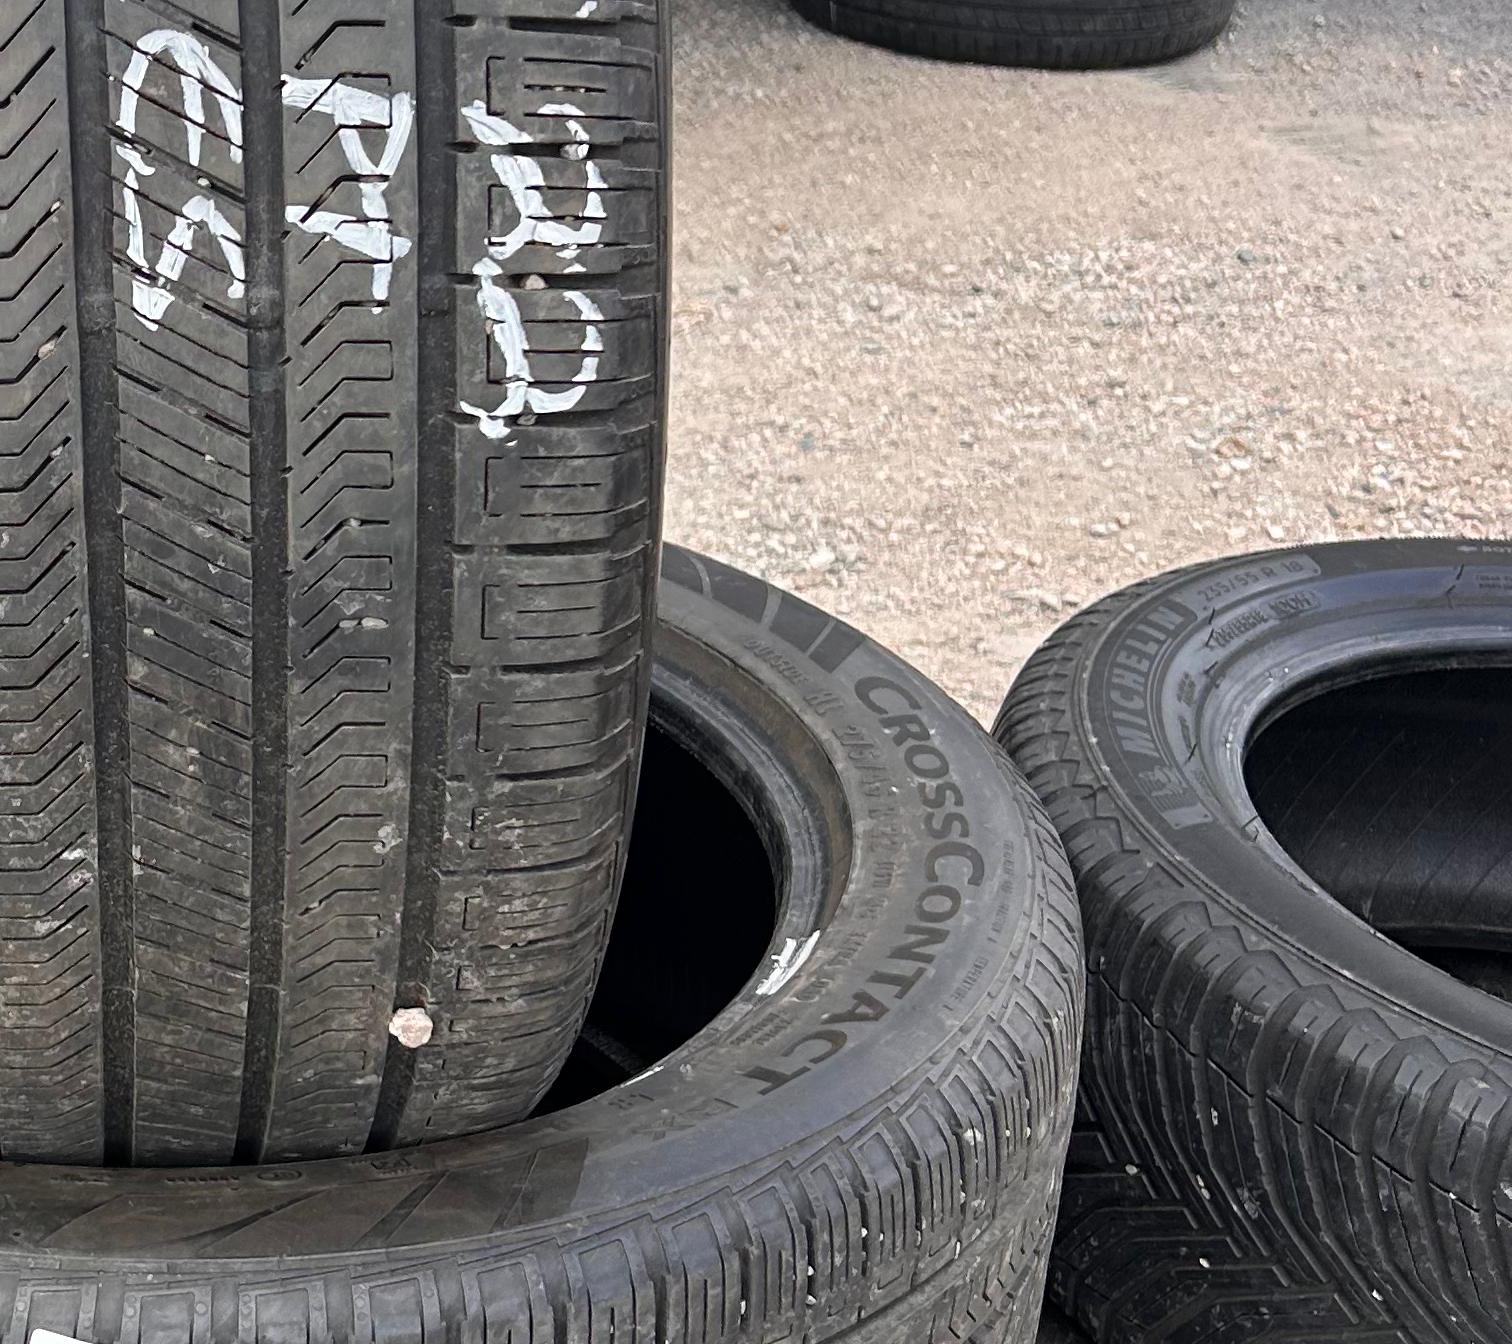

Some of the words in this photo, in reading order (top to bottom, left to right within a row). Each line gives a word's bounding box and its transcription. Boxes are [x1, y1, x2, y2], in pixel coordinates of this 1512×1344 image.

[1196, 571, 1260, 602] 235/55
[1284, 560, 1304, 574] 18
[1109, 605, 1186, 758] MICHELIN
